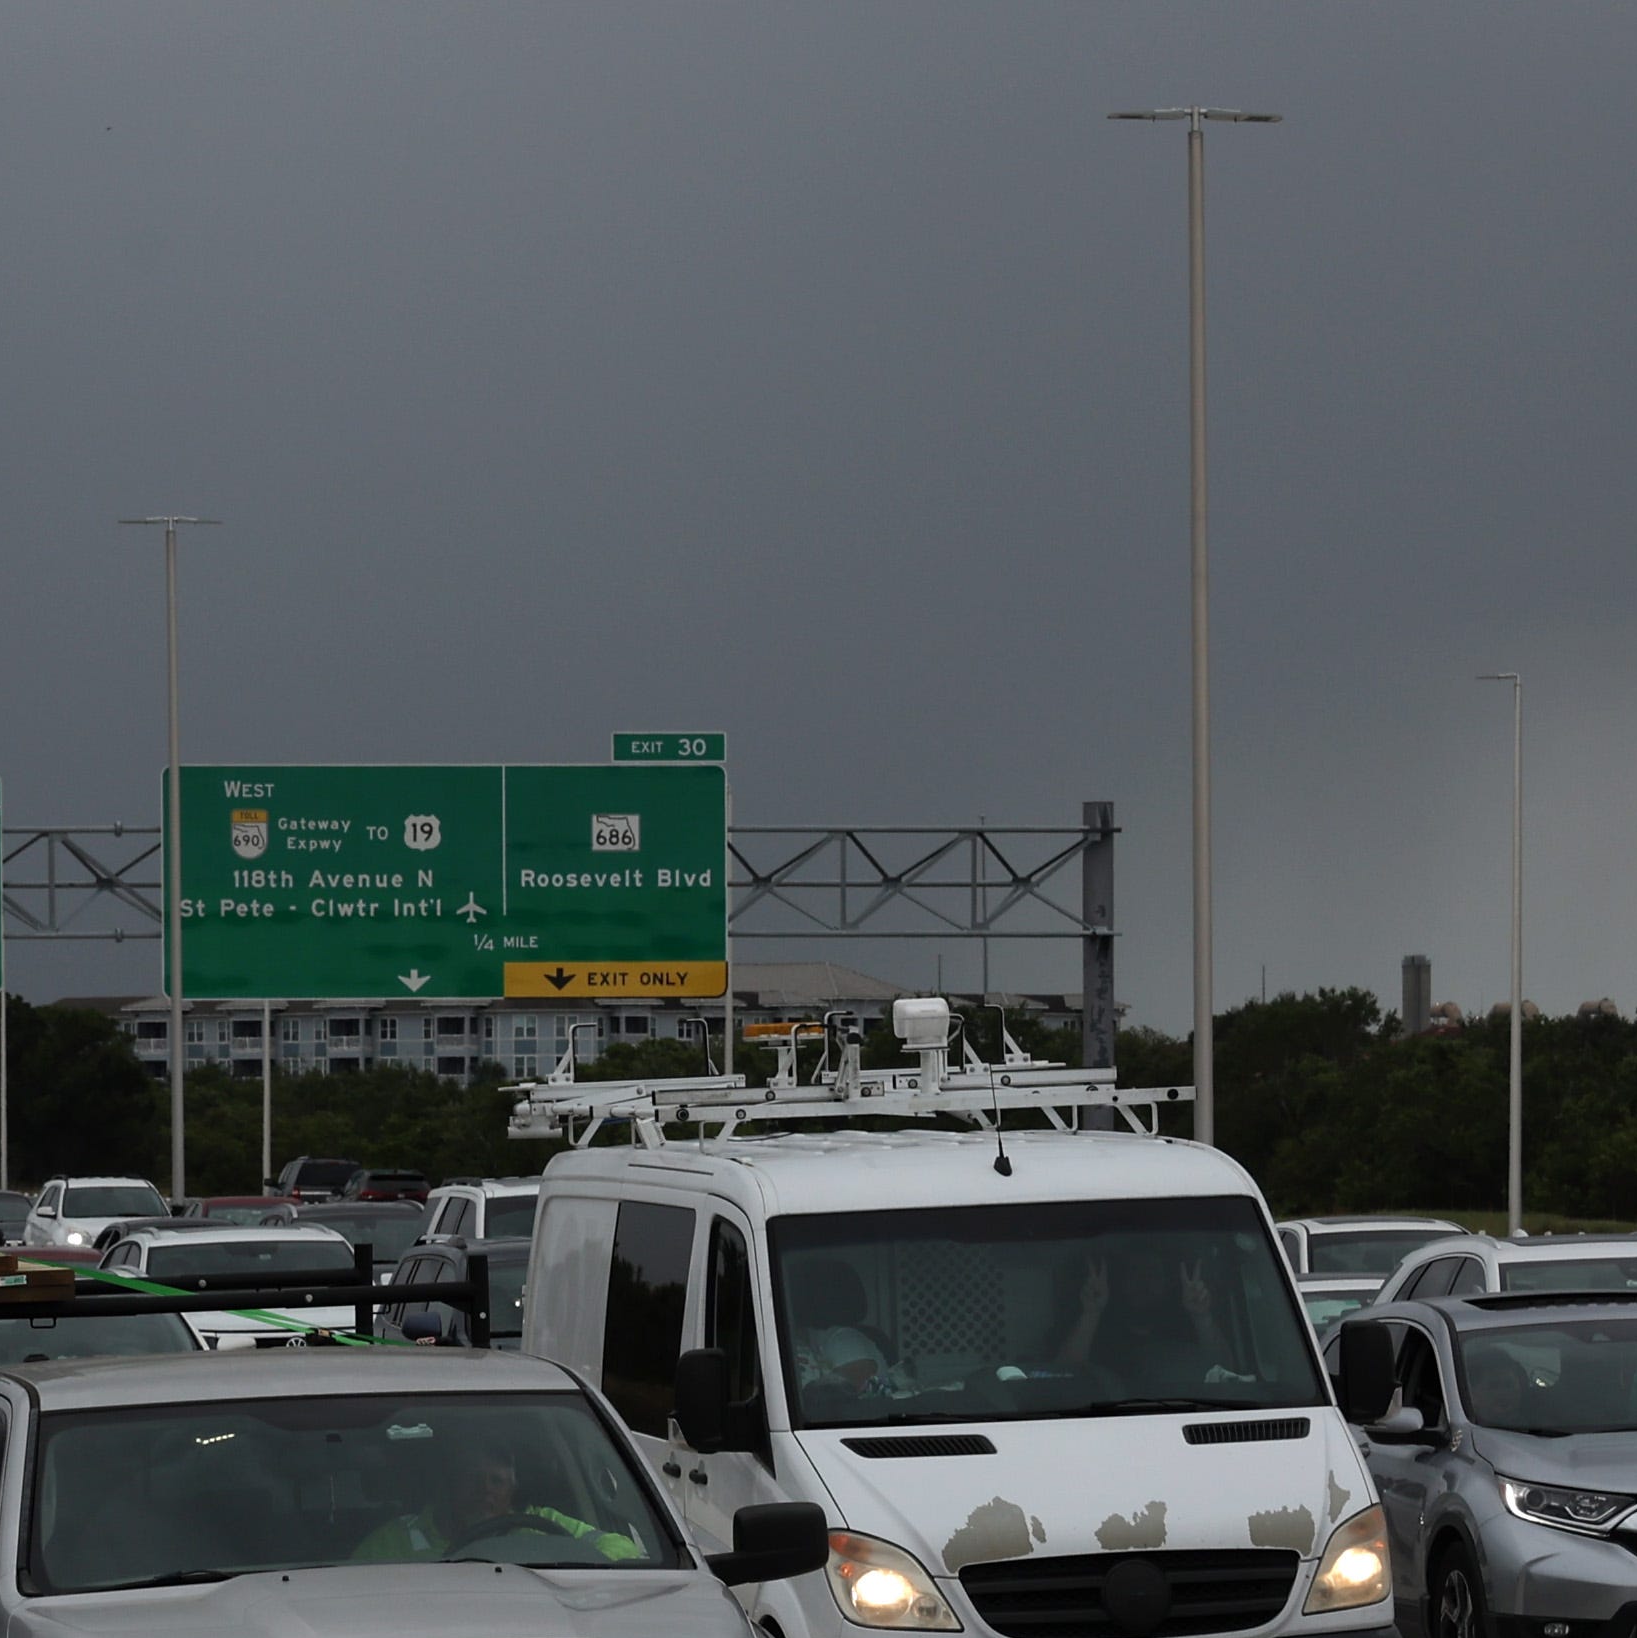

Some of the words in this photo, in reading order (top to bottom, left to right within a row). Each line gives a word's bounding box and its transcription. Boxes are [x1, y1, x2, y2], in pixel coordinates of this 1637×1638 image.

[631, 741, 664, 753] EXIT
[678, 738, 707, 756] 30
[224, 781, 275, 798] WEST
[239, 812, 259, 820] TOLL
[278, 817, 351, 833] Gateway
[411, 821, 434, 843] 19
[233, 835, 260, 847] 690
[366, 826, 389, 841] TO
[595, 828, 633, 847] 686
[286, 837, 342, 853] Expwy
[232, 869, 293, 888] 118th
[309, 869, 404, 888] Avenue
[418, 869, 434, 888] N
[520, 869, 643, 888] Roosevelt
[657, 869, 712, 888] Blvd
[180, 899, 206, 918] St
[220, 899, 275, 918] Pete
[311, 898, 380, 918] Clwtr
[394, 898, 443, 918] Int'l
[503, 935, 539, 949] MILE
[587, 971, 629, 987] EXIT
[639, 971, 690, 987] ONLY
